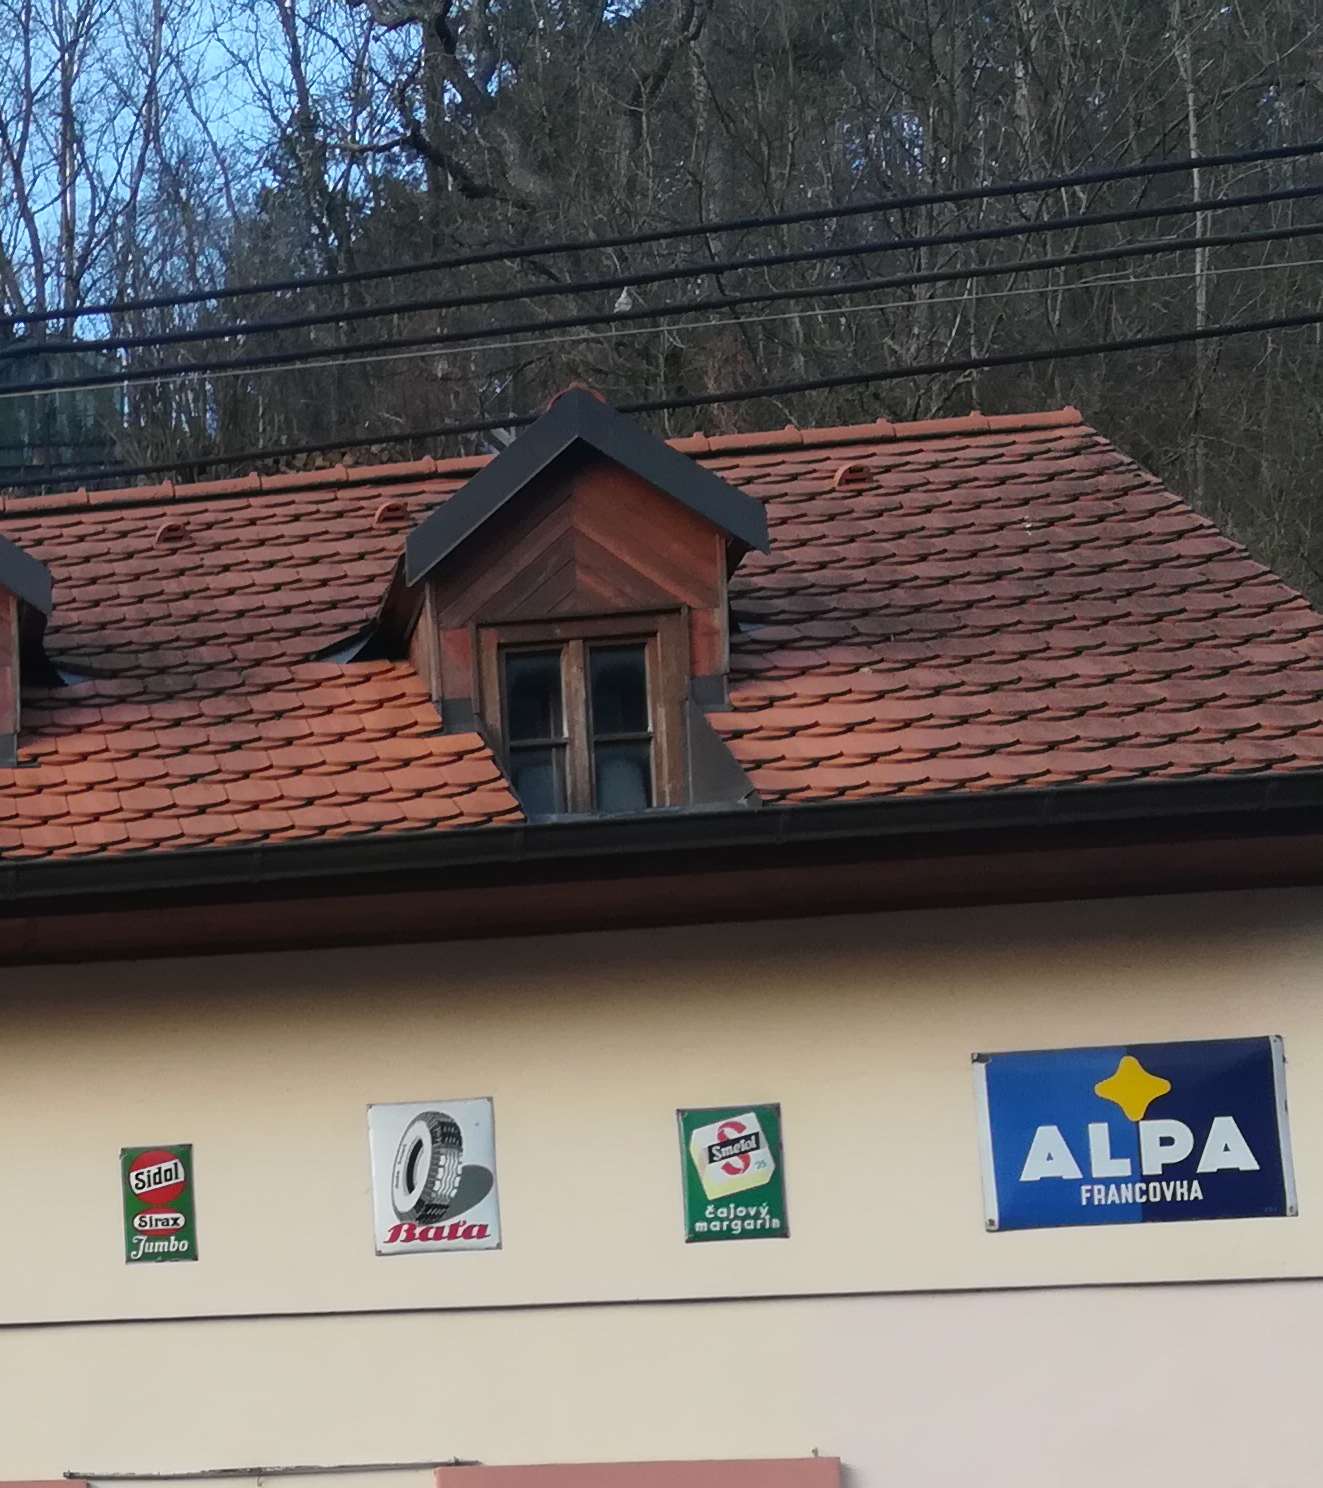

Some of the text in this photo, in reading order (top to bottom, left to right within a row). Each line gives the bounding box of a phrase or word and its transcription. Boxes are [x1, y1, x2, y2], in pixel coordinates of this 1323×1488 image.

[711, 1134, 758, 1161] Smetol
[1019, 1115, 1260, 1182] ALPA
[134, 1162, 180, 1191] Sidol
[1080, 1179, 1203, 1206] FRANCOVKA
[137, 1214, 181, 1229] Sirax
[704, 1201, 770, 1219] čajový
[383, 1219, 491, 1244] Baťa
[130, 1234, 189, 1260] Jumbo
